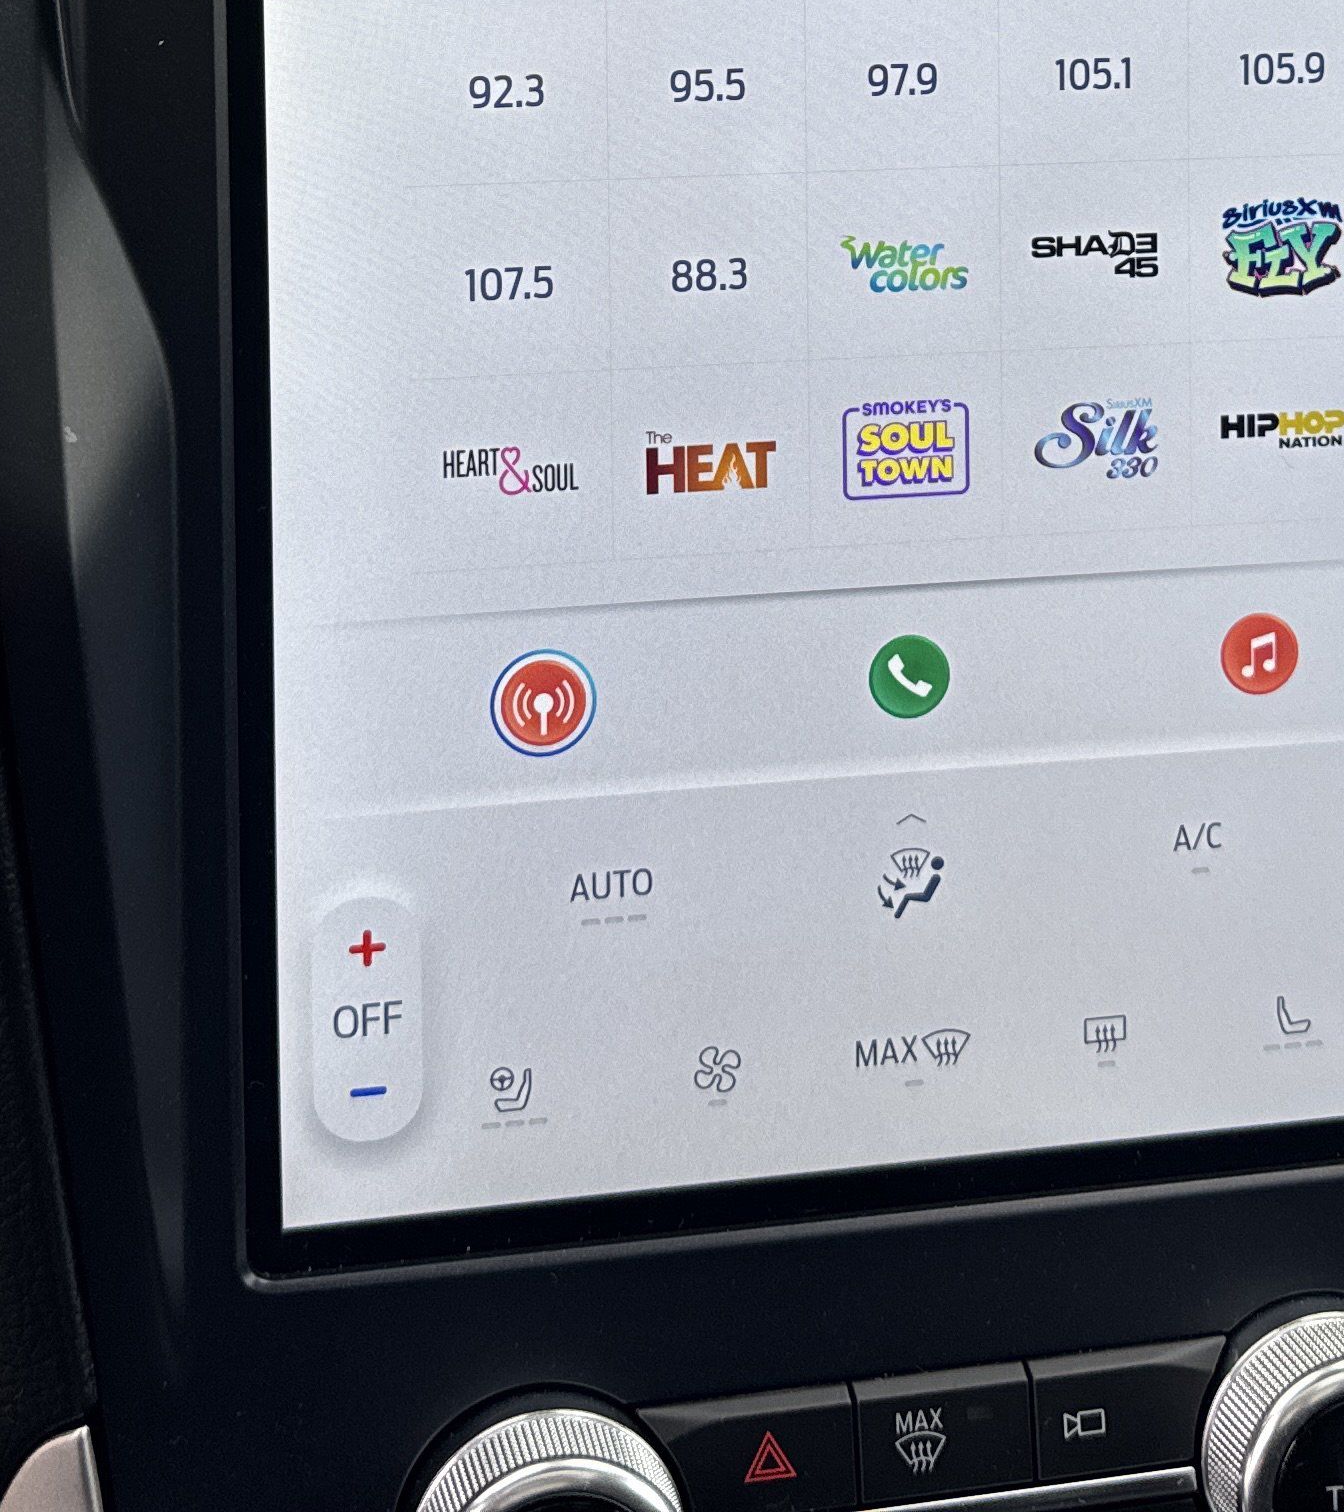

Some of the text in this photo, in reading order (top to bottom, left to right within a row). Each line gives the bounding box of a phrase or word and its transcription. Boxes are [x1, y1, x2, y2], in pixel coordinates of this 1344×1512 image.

[669, 67, 746, 103] 95.5
[866, 61, 938, 97] 97.9
[1054, 56, 1132, 91] 105.1
[1238, 51, 1326, 86] 105.9
[468, 73, 545, 109] 92.3
[840, 235, 945, 270] Water
[1031, 229, 1158, 258] SHADE
[1222, 220, 1342, 298] FLY
[464, 265, 554, 302] 107.5
[671, 257, 748, 293] 88.3
[869, 260, 969, 293] colors
[1113, 256, 1159, 278] 45
[645, 430, 673, 446] The
[857, 419, 955, 456] SOUL
[1034, 401, 1159, 469] Silk
[1278, 433, 1344, 449] NATION
[645, 440, 777, 496] HEAT
[857, 454, 955, 487] TOWN
[1106, 455, 1159, 479] 330
[1172, 821, 1223, 852] A/C
[569, 867, 654, 903] AUTO
[332, 999, 404, 1039] OFF
[855, 1034, 920, 1068] MAX
[895, 1406, 945, 1433] MAX
